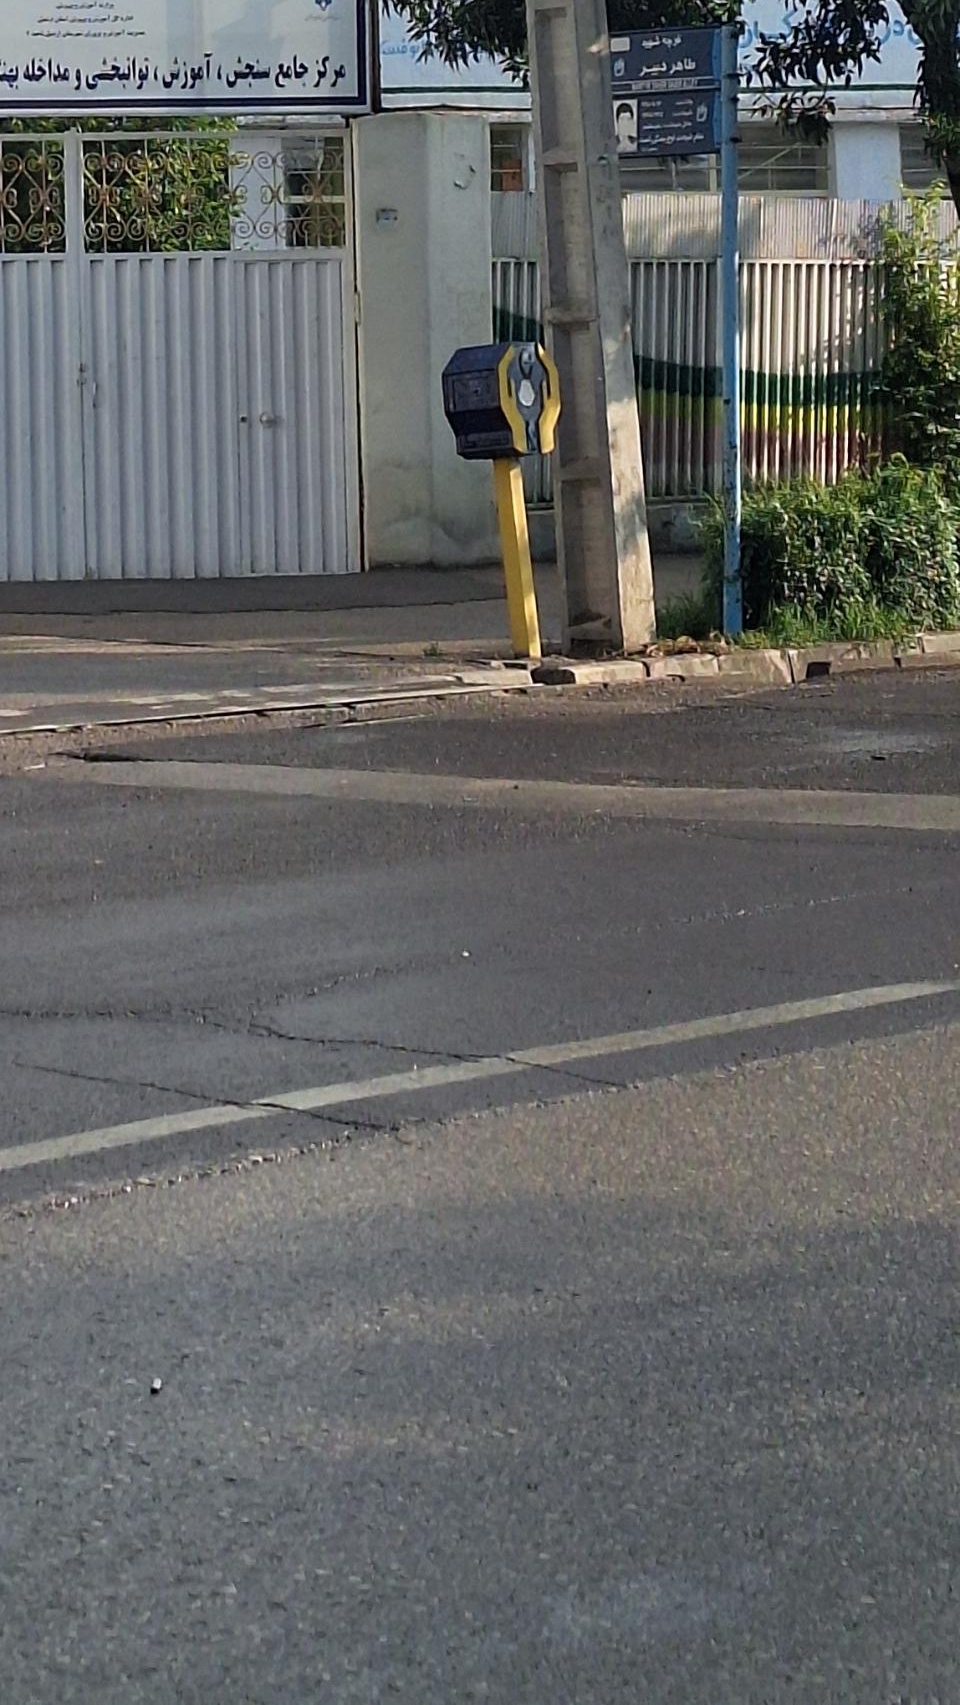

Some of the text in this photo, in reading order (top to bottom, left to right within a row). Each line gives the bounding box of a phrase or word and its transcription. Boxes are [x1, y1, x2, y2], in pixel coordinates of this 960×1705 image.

[22, 57, 71, 82] مداخله
[73, 68, 82, 91] و
[85, 56, 149, 91] توانبخشی
[274, 54, 309, 89] جامع
[312, 55, 347, 89] مرکز
